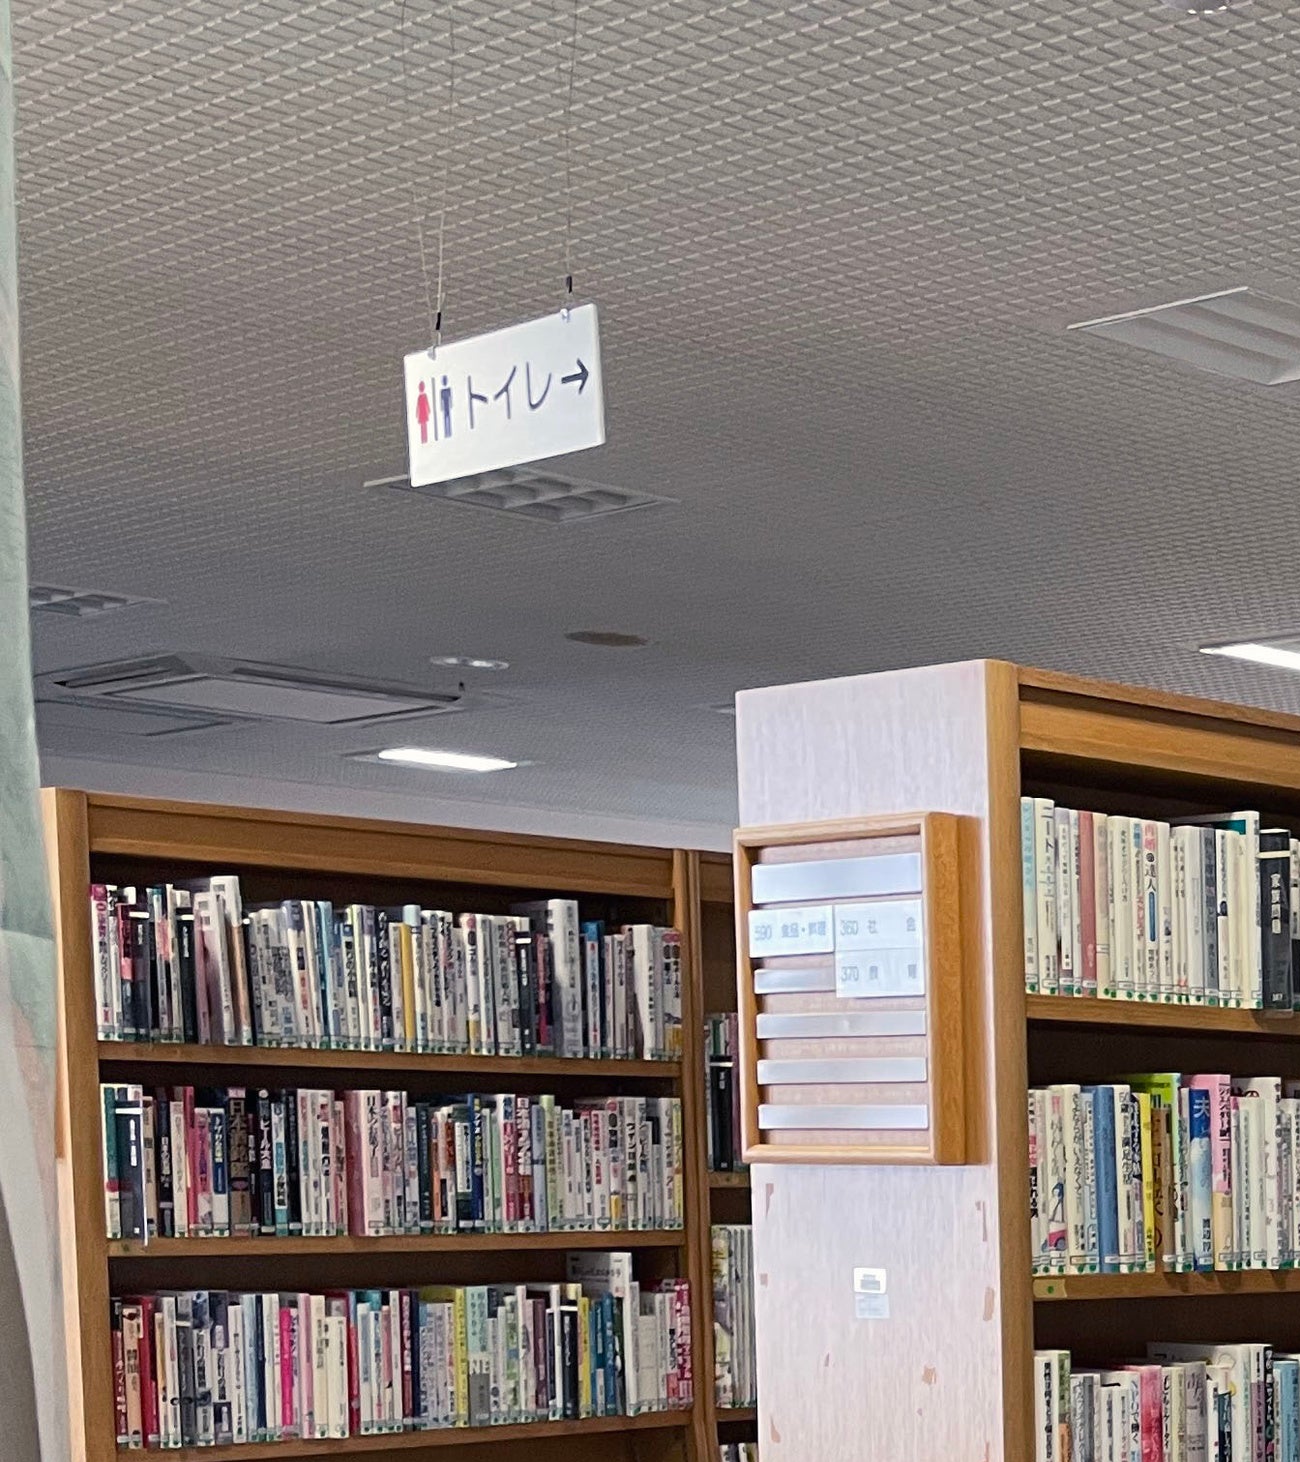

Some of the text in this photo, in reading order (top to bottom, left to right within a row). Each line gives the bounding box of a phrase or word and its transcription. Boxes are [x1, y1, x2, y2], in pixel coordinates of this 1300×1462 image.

[466, 361, 553, 430] トイレ
[840, 965, 860, 982] 370
